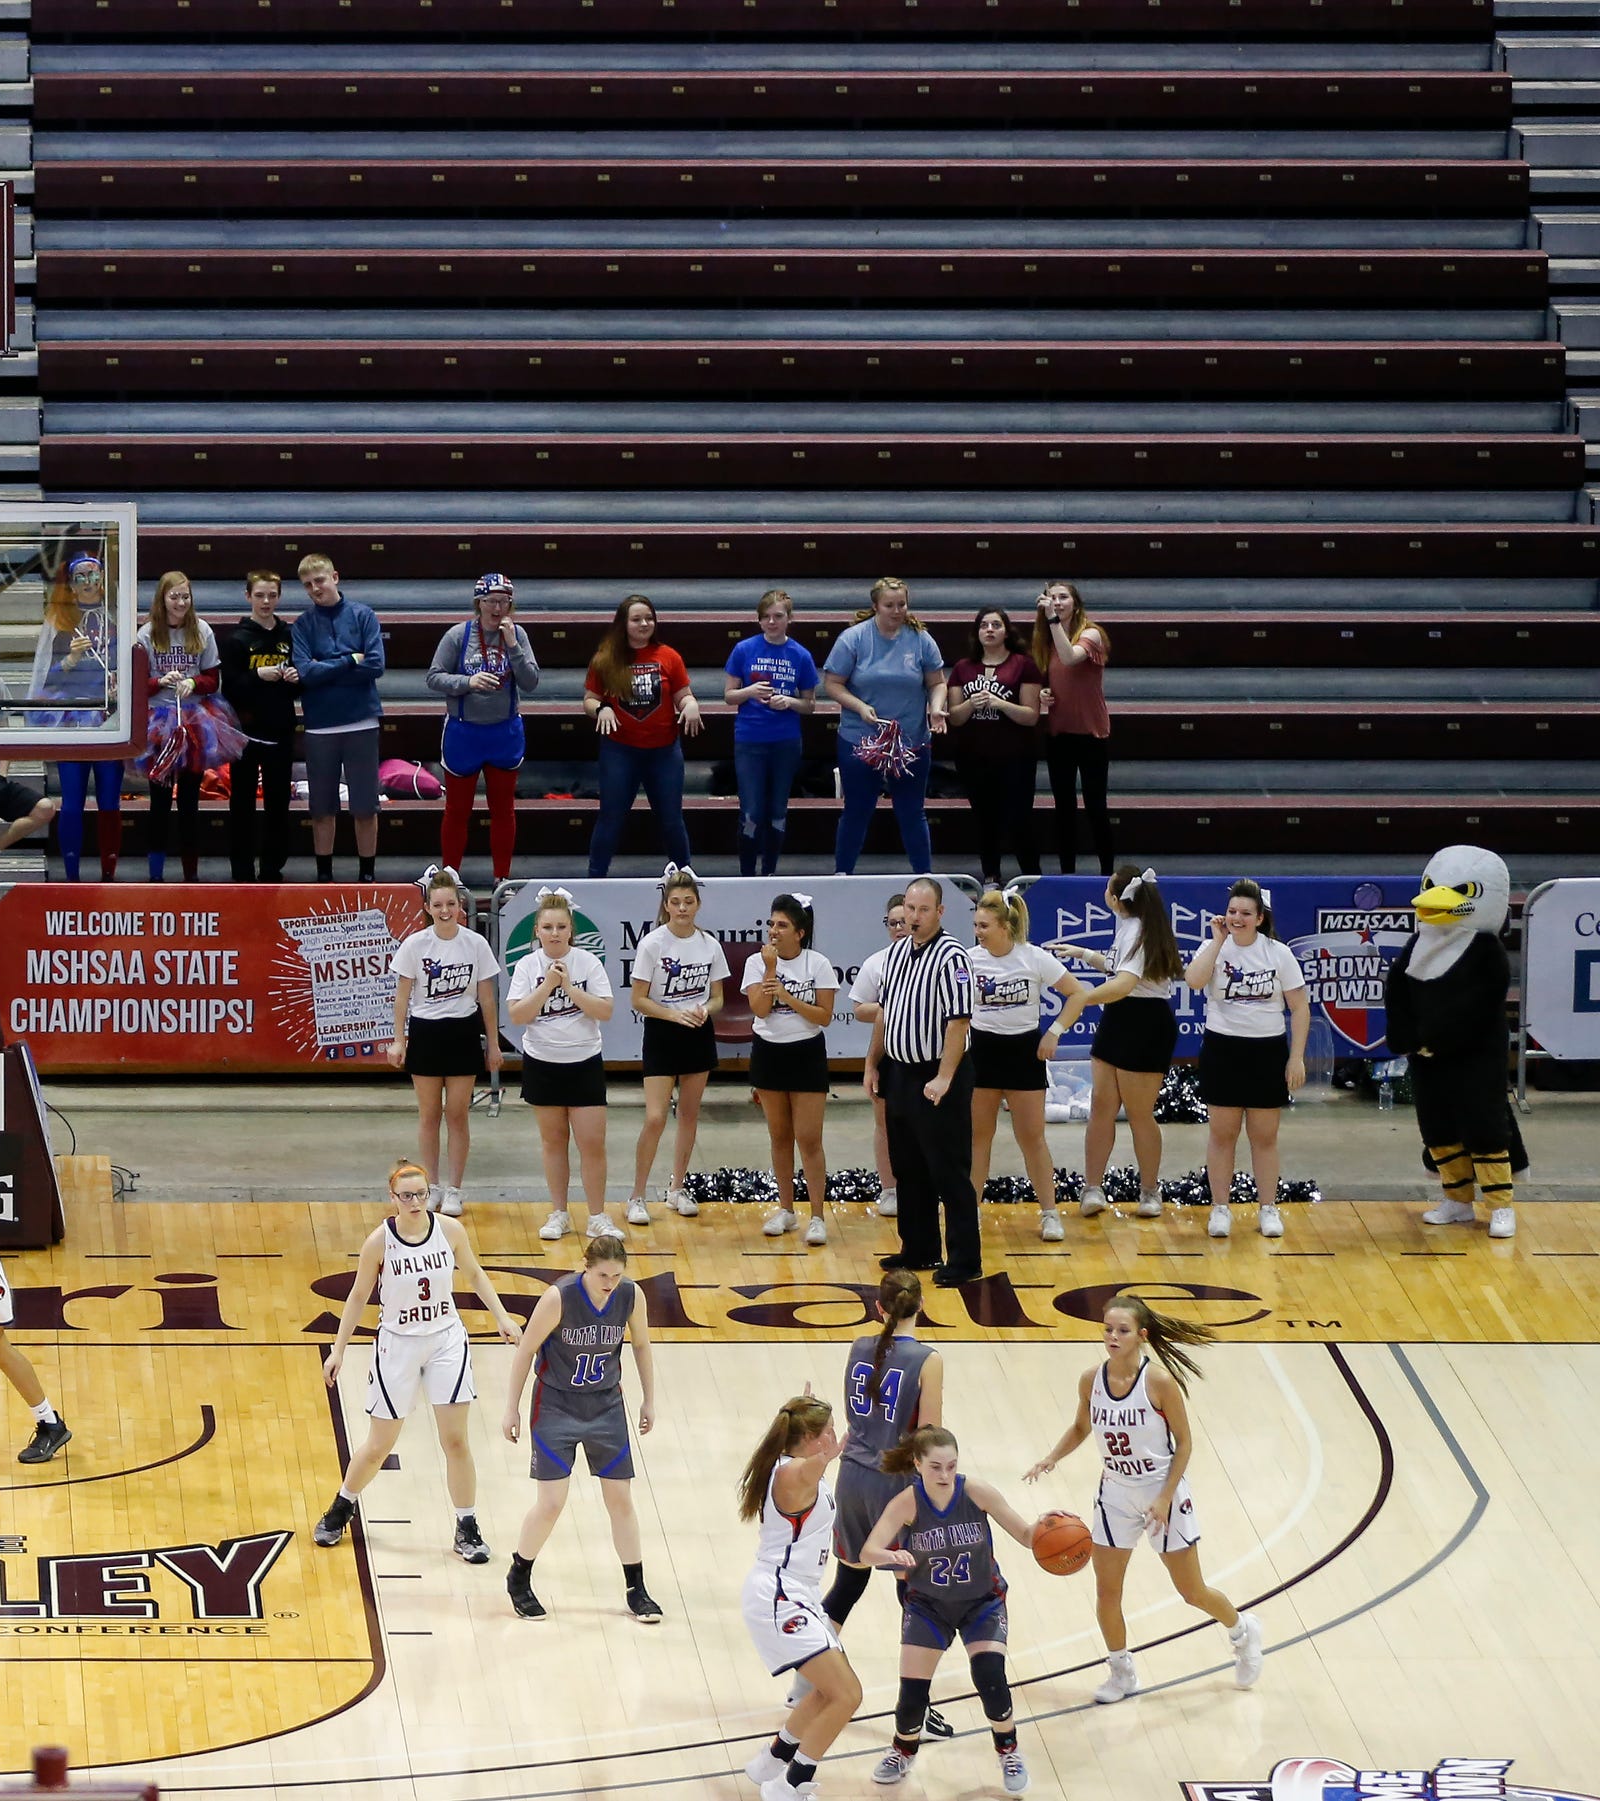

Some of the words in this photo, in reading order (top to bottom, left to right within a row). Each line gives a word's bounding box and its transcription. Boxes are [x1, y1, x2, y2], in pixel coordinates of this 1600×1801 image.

[153, 654, 198, 666] TROUBLE
[45, 910, 145, 936] WELCOME
[150, 911, 176, 936] TO
[181, 911, 220, 937] THE
[284, 913, 358, 930] SPORTSMANSHIP
[292, 926, 339, 937] BASEBALL
[341, 923, 366, 935] Sports
[1324, 914, 1410, 930] MSHSAA
[324, 938, 393, 951] CITIZENSHIP
[26, 949, 145, 984] MSHSAA
[153, 949, 239, 985] STATE
[314, 954, 396, 984] MSHSA
[1304, 956, 1392, 981] SHOW-
[10, 998, 254, 1033] CHAMPIONSHIPS!
[318, 1021, 376, 1036] LEADERSHIP
[391, 1251, 449, 1276] WALNUT
[418, 1277, 431, 1301] 3
[398, 1301, 450, 1325] GROVE
[571, 1352, 611, 1387] 15
[849, 1361, 905, 1423] 34
[1104, 1432, 1132, 1456] 22
[928, 1552, 971, 1587] 24
